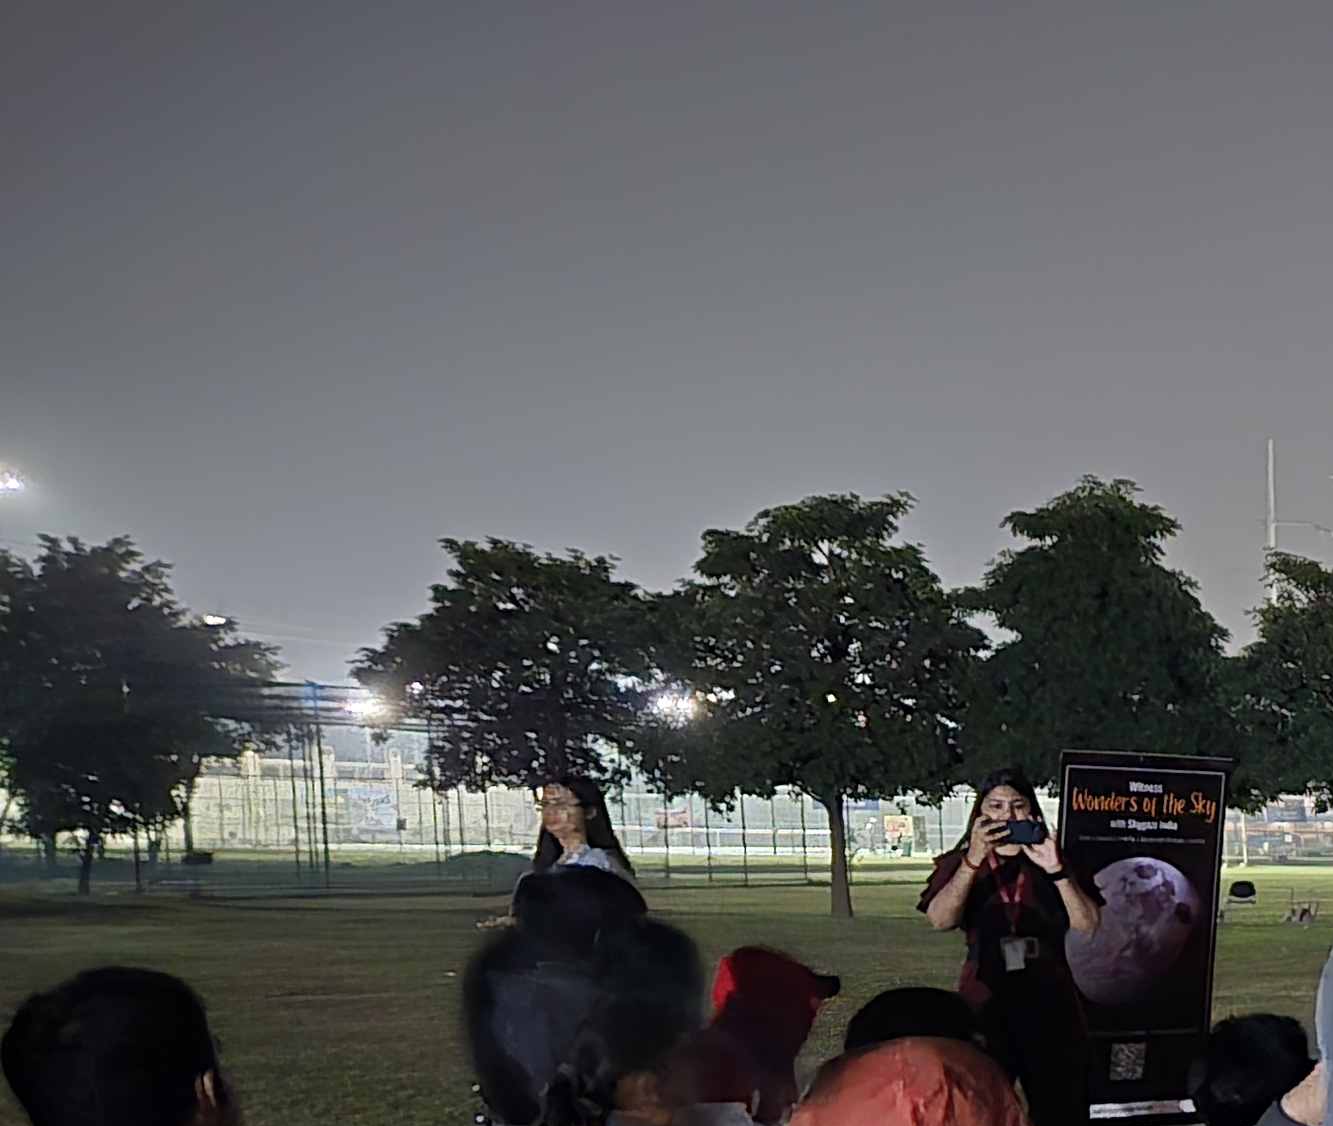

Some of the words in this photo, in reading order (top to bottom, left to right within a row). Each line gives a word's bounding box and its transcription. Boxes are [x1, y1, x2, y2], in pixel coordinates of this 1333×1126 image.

[1072, 786, 1138, 813] Wonders
[1142, 796, 1157, 818] of
[1163, 792, 1186, 816] the
[1189, 790, 1216, 824] Sky
